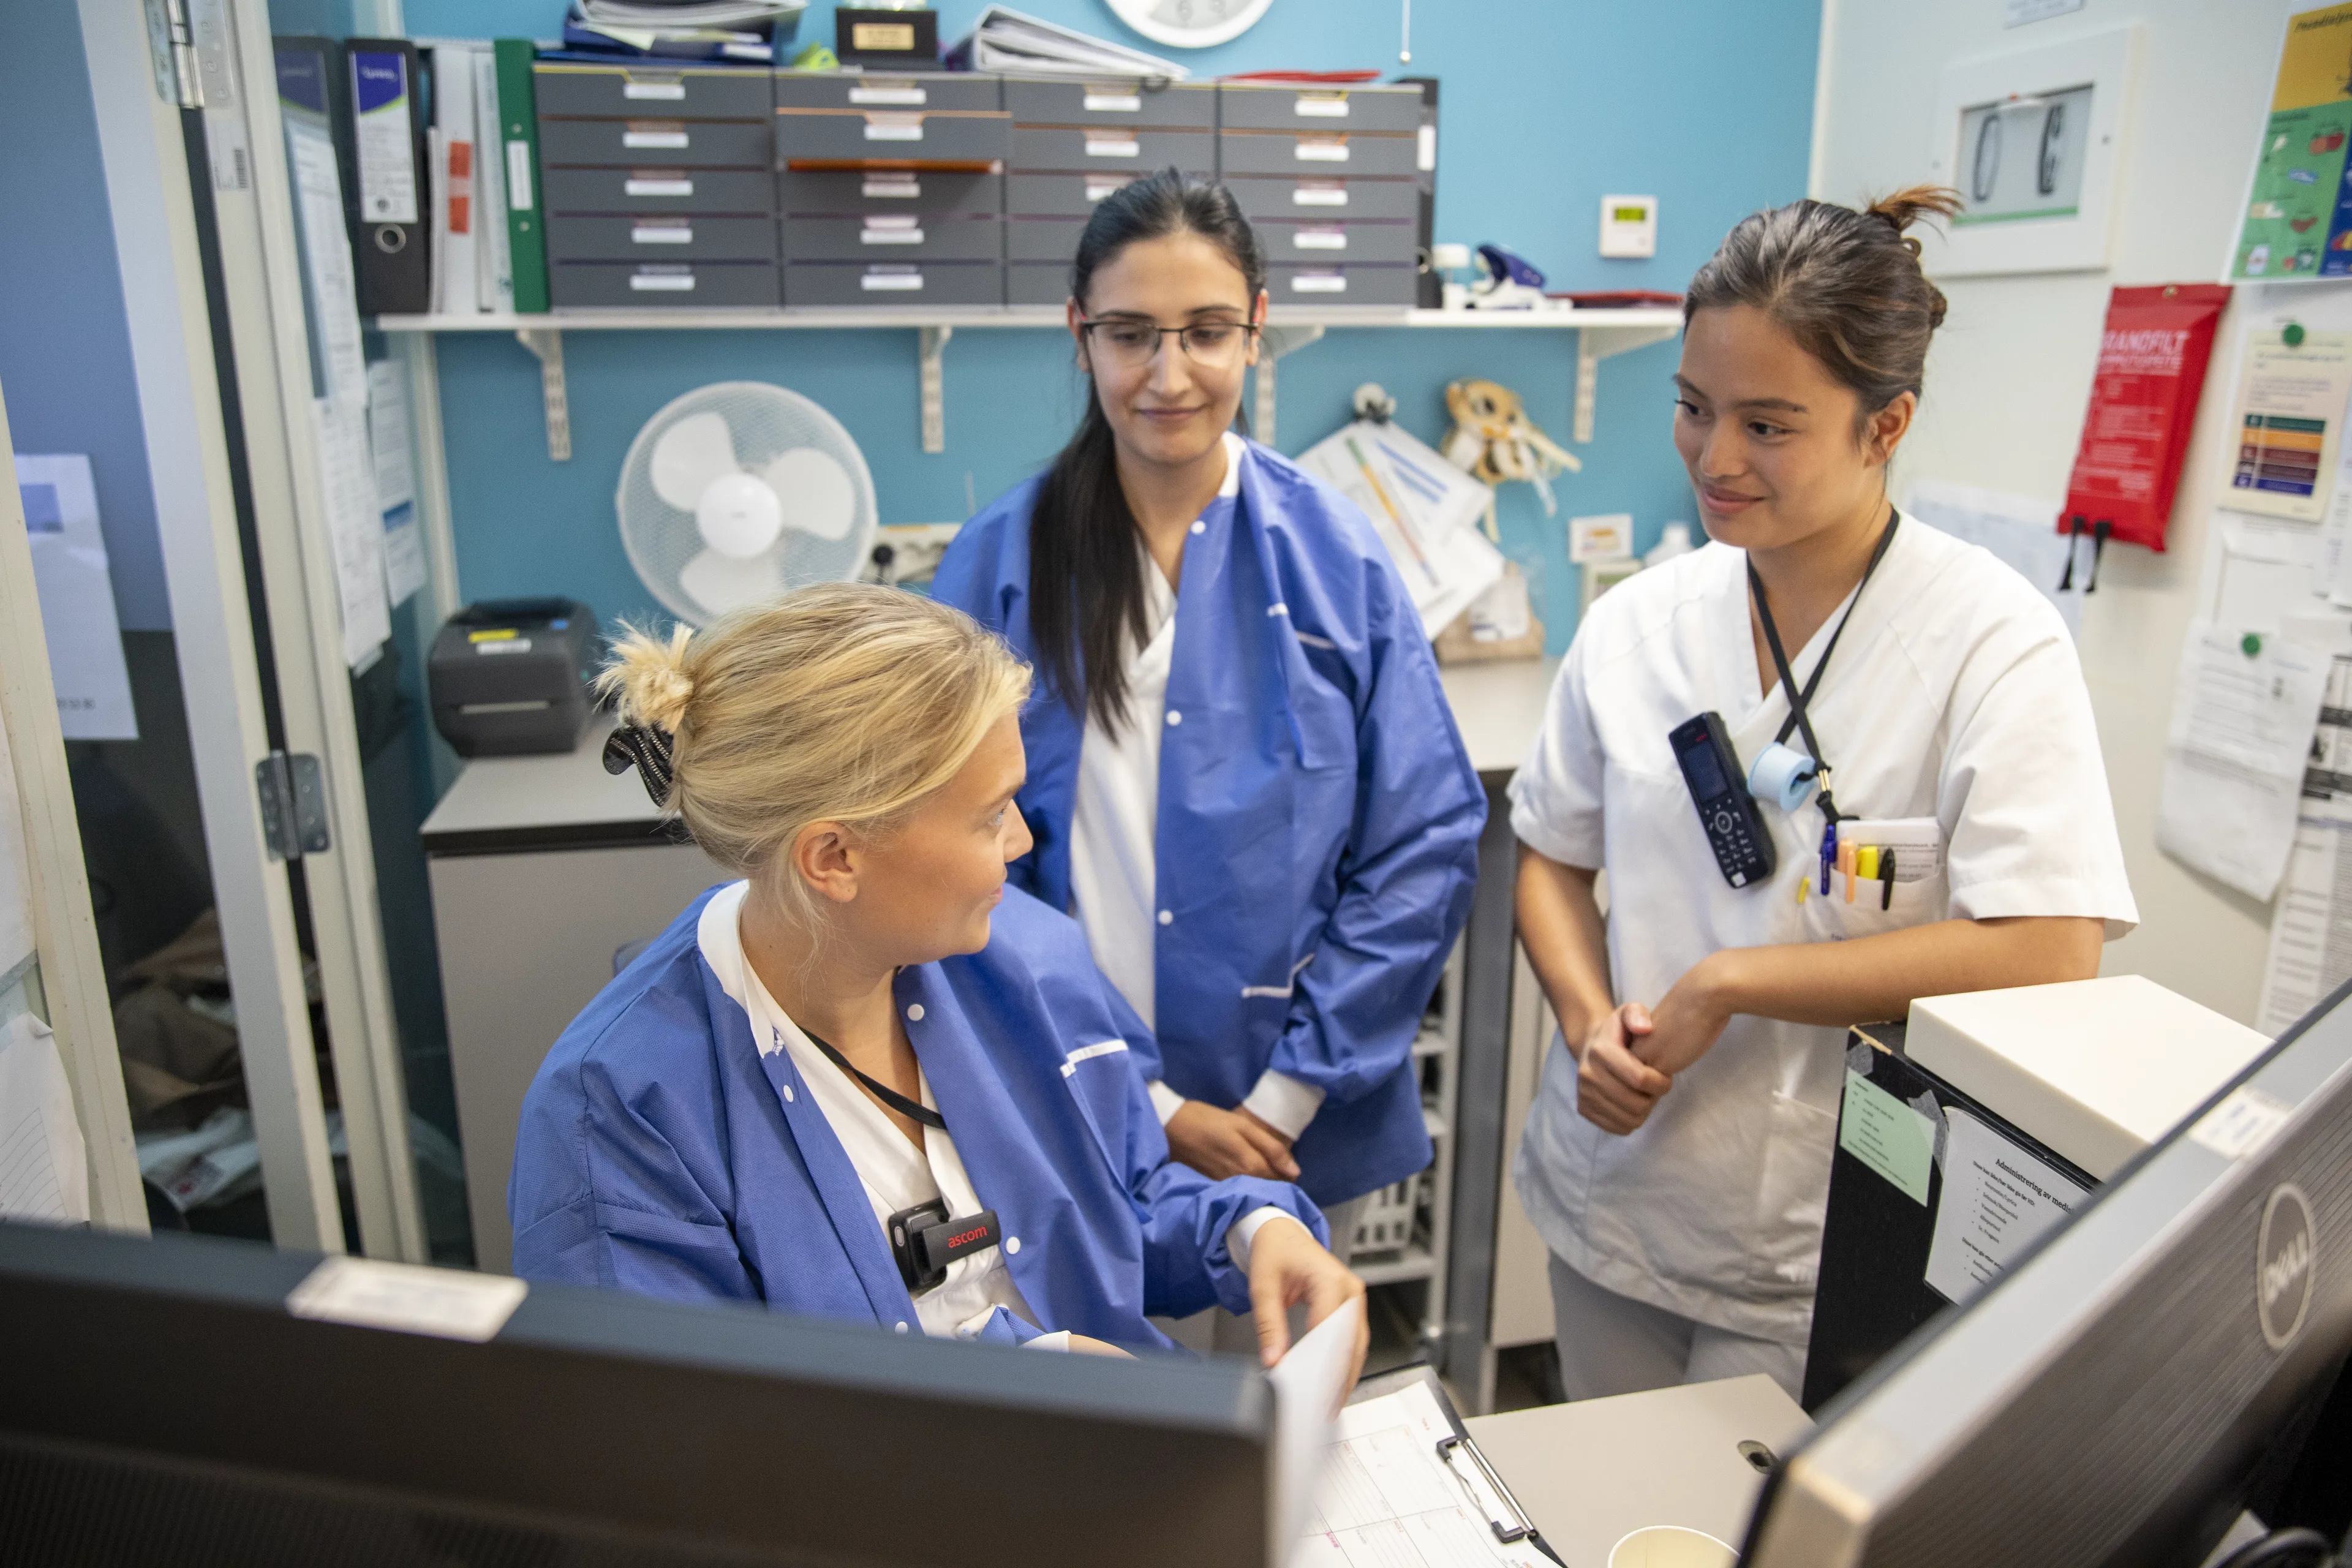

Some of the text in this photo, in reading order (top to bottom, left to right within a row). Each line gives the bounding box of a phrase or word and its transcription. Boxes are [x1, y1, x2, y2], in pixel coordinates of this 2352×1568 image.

[1995, 1158, 2073, 1215] Administrering av medis
[948, 1226, 987, 1248] ascom
[2264, 1230, 2308, 1305] DELL
